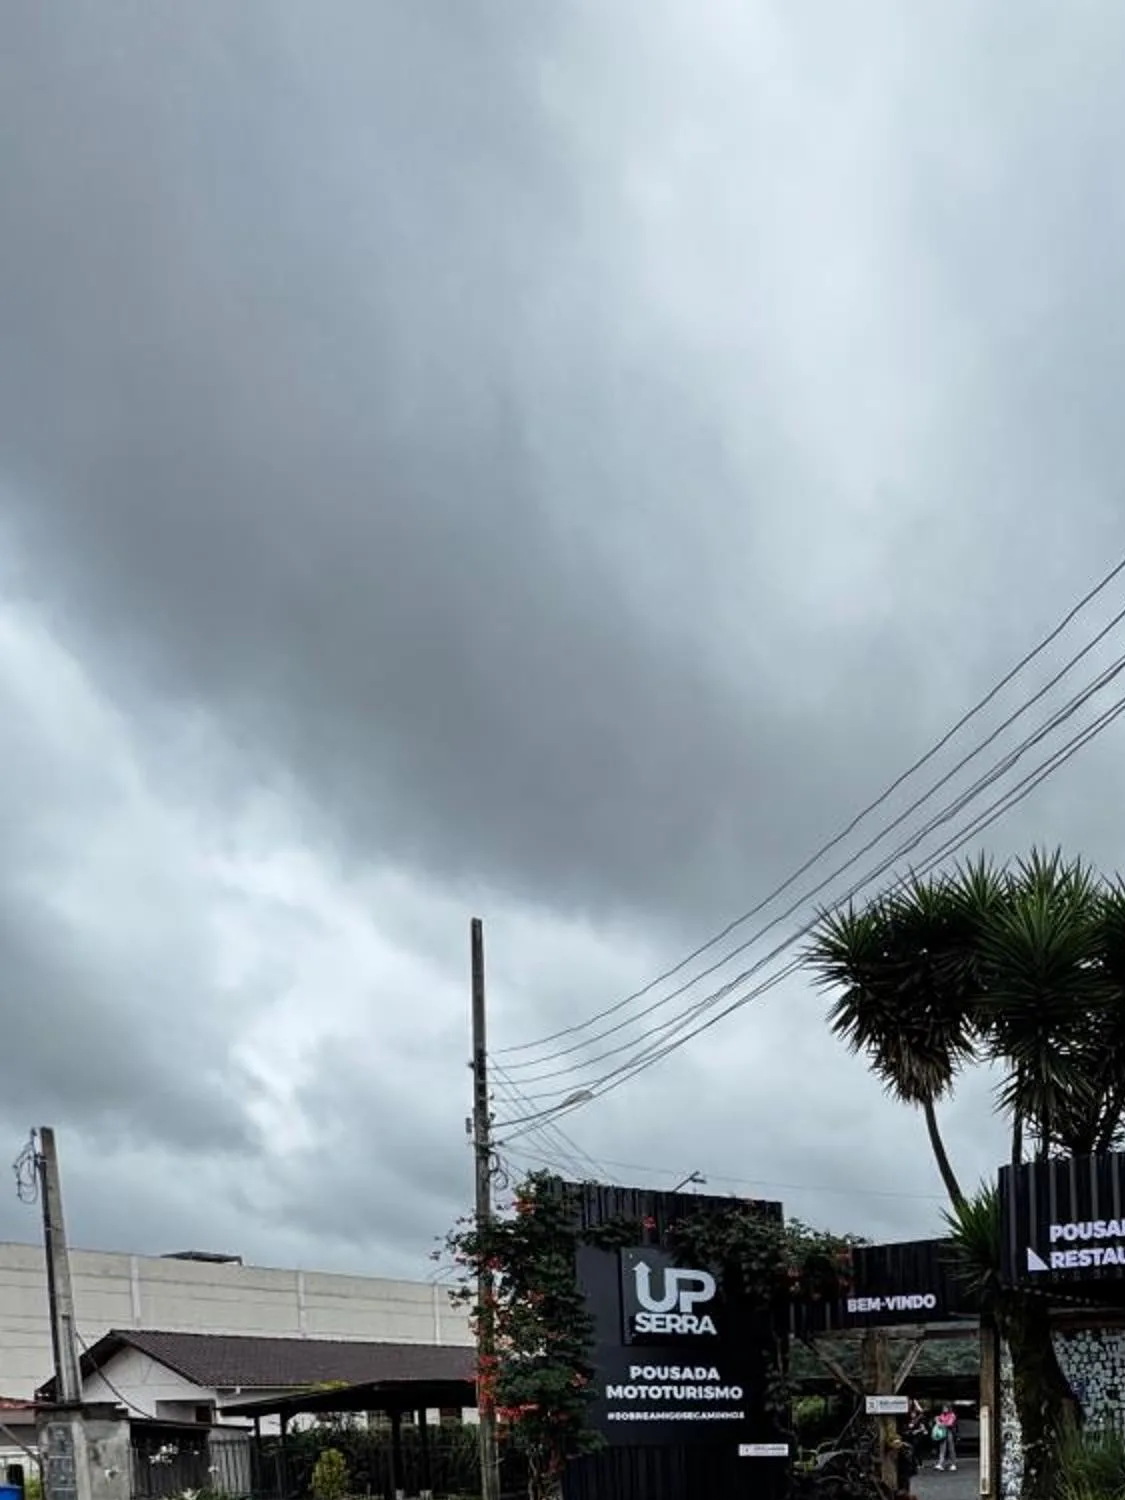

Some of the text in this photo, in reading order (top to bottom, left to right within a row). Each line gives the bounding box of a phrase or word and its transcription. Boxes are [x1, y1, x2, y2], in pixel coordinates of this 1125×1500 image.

[632, 1261, 716, 1312] UP
[847, 1294, 936, 1312] BEM-VINDO
[635, 1312, 717, 1335] SERRA
[629, 1365, 721, 1381] POUSADA
[605, 1385, 744, 1400] MOTOTURISMO
